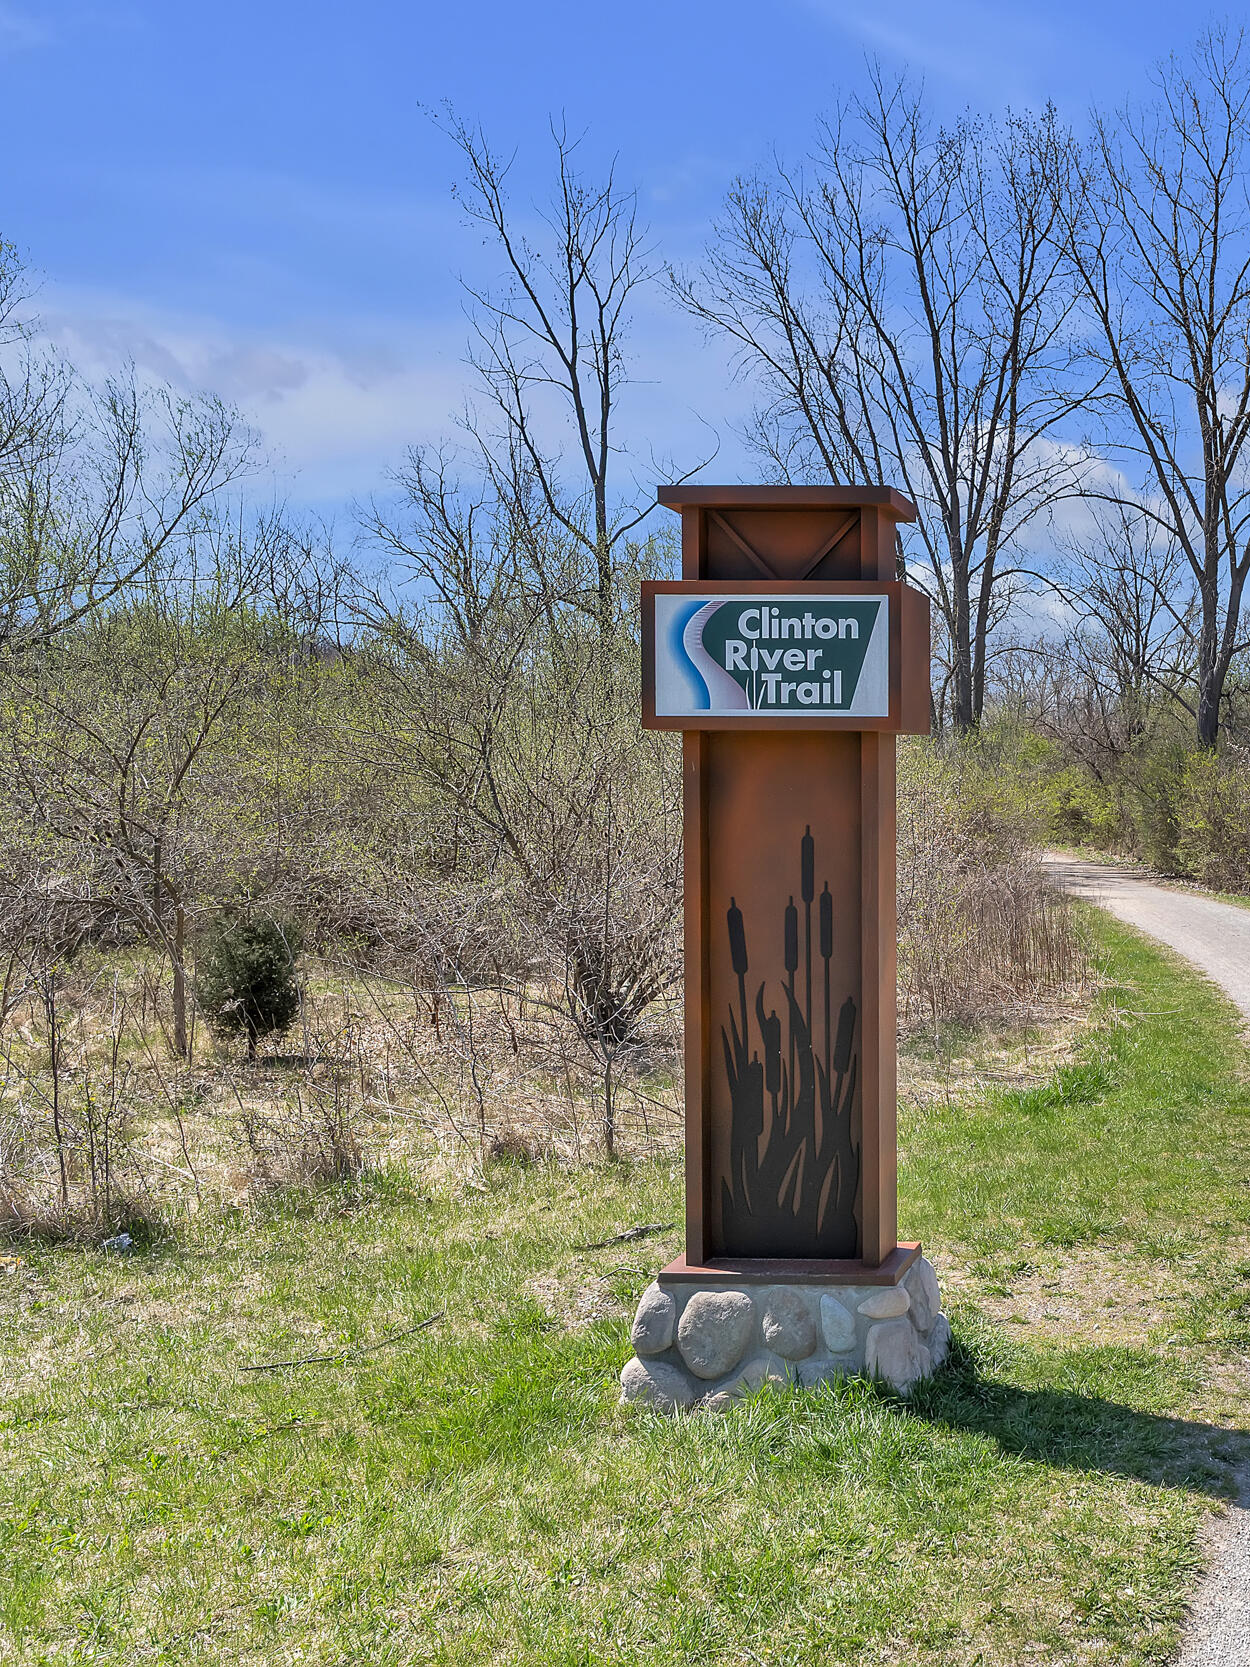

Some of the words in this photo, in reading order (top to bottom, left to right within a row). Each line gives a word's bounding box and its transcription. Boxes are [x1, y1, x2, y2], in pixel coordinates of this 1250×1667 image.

[738, 606, 859, 640] Clinton
[725, 640, 823, 671] River
[761, 671, 842, 704] Trail
